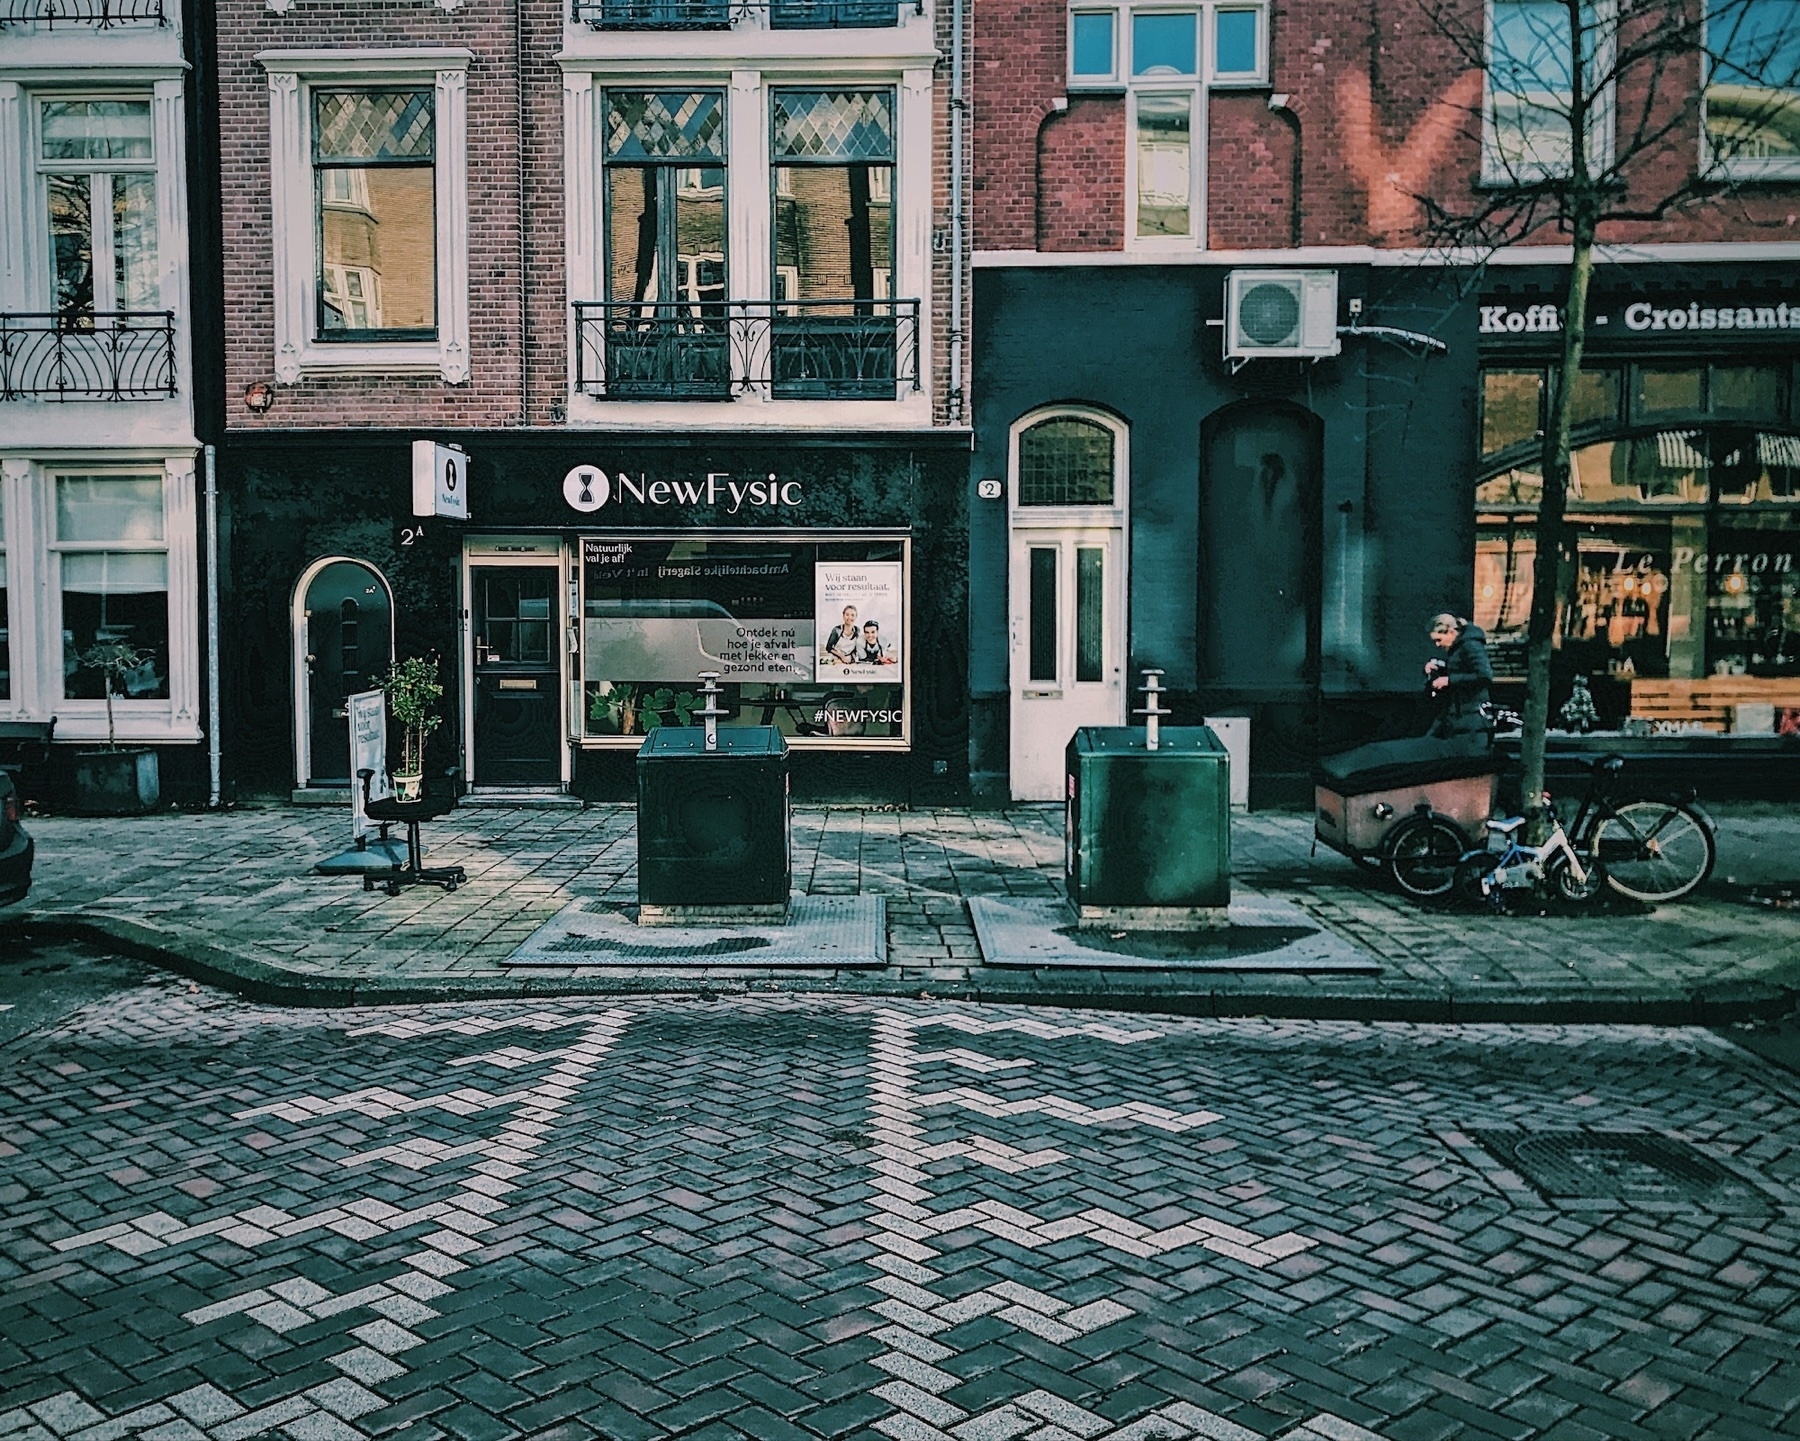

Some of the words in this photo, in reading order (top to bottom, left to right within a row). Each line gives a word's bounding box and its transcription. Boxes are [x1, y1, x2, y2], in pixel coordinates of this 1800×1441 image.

[1479, 304, 1563, 333] Koffi
[618, 473, 802, 514] NewFysic
[984, 482, 995, 496] 2
[585, 543, 633, 554] Natuurlijk
[585, 554, 599, 563] val
[600, 554, 610, 565] je
[611, 554, 625, 563] af!
[1612, 549, 1653, 575] Le
[1670, 546, 1793, 575] Perron
[825, 573, 841, 582] Wij
[842, 573, 867, 582] staan
[847, 582, 890, 591] resultaat.
[736, 627, 778, 638] Ontdek
[781, 627, 795, 637] nú
[727, 639, 748, 649] hoe
[750, 639, 761, 651] je
[763, 639, 796, 649] afvalt
[719, 651, 742, 661] met
[744, 650, 780, 661] lekker
[781, 652, 795, 661] en
[723, 662, 765, 674] gezond
[767, 663, 796, 673] eten.
[814, 709, 903, 723] #NEWFYSIC
